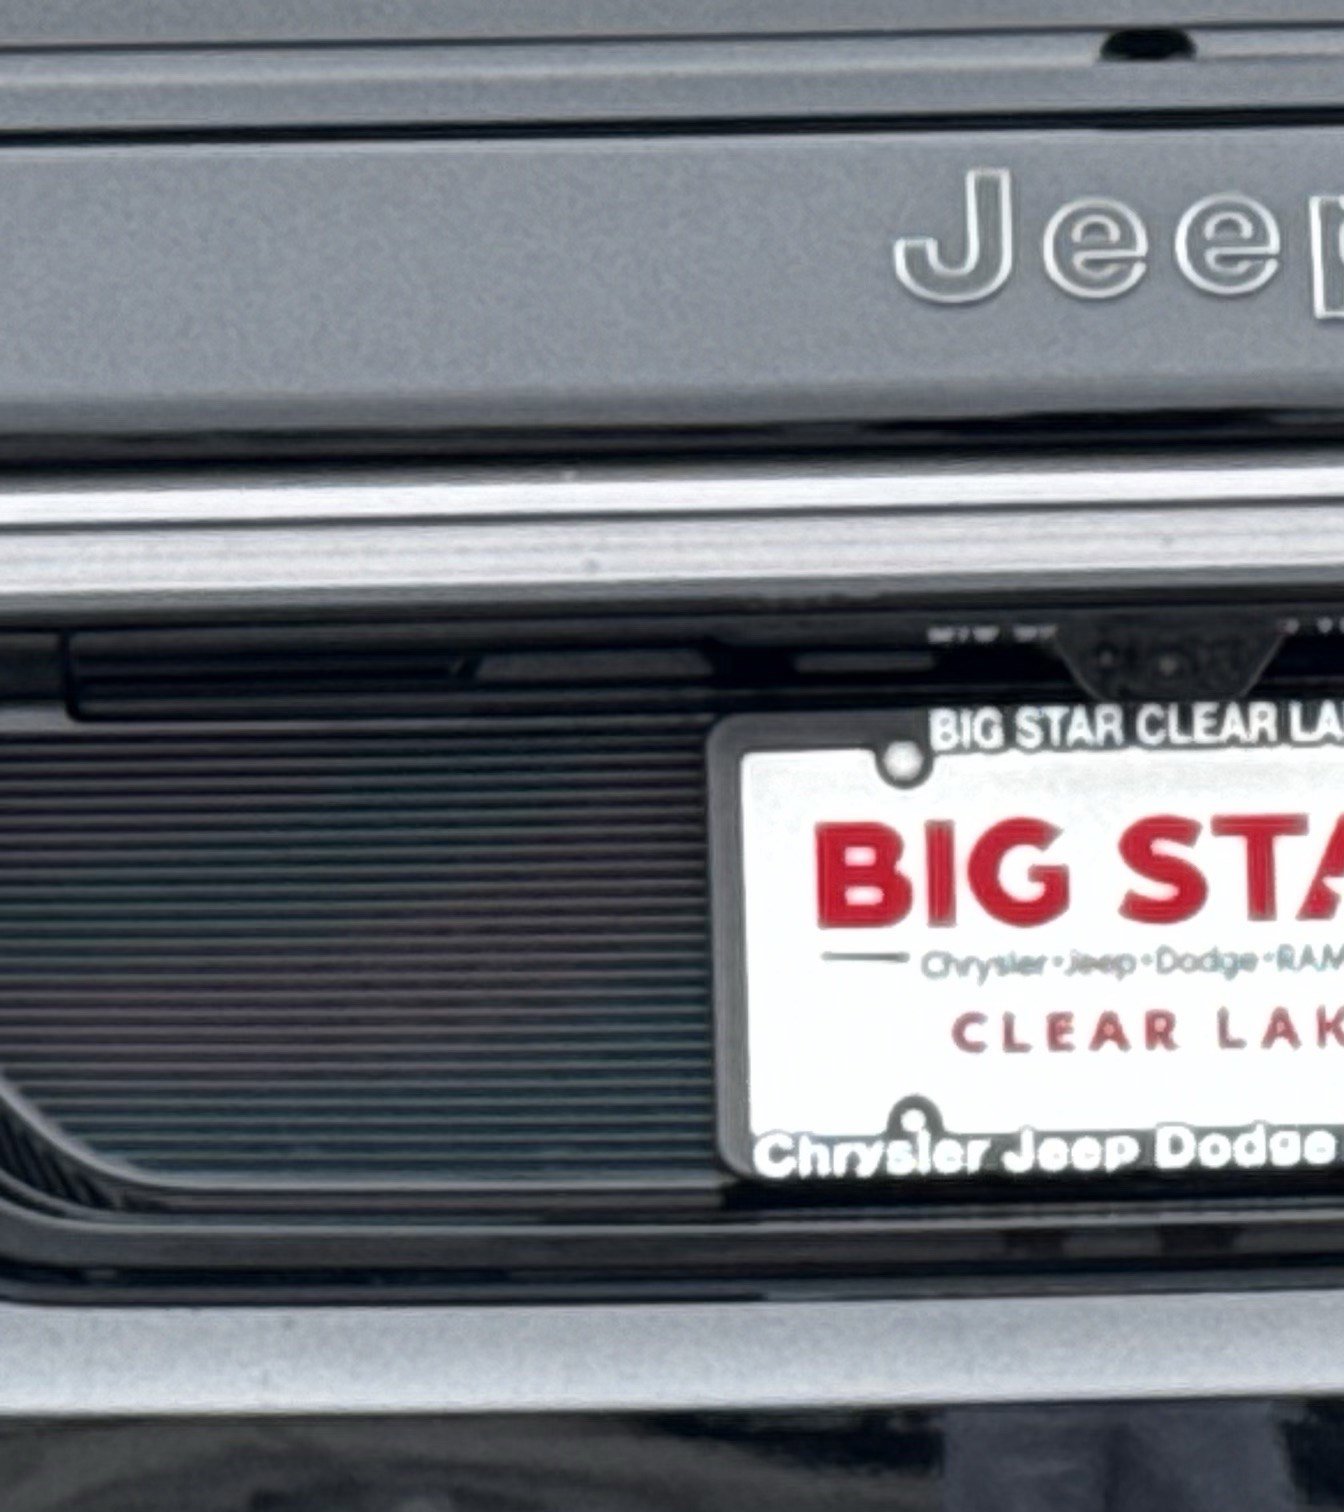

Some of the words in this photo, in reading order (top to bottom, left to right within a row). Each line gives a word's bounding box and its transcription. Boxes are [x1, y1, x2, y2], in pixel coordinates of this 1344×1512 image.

[928, 706, 1004, 752] BIG
[1014, 703, 1125, 750] STAR
[1136, 701, 1278, 747] CLEAR
[814, 816, 1070, 929] BIG
[951, 1007, 1179, 1054] CLEAR
[753, 1131, 990, 1179] Chrysler
[1002, 1125, 1140, 1173] Jeep
[1155, 1122, 1338, 1170] Dodge
